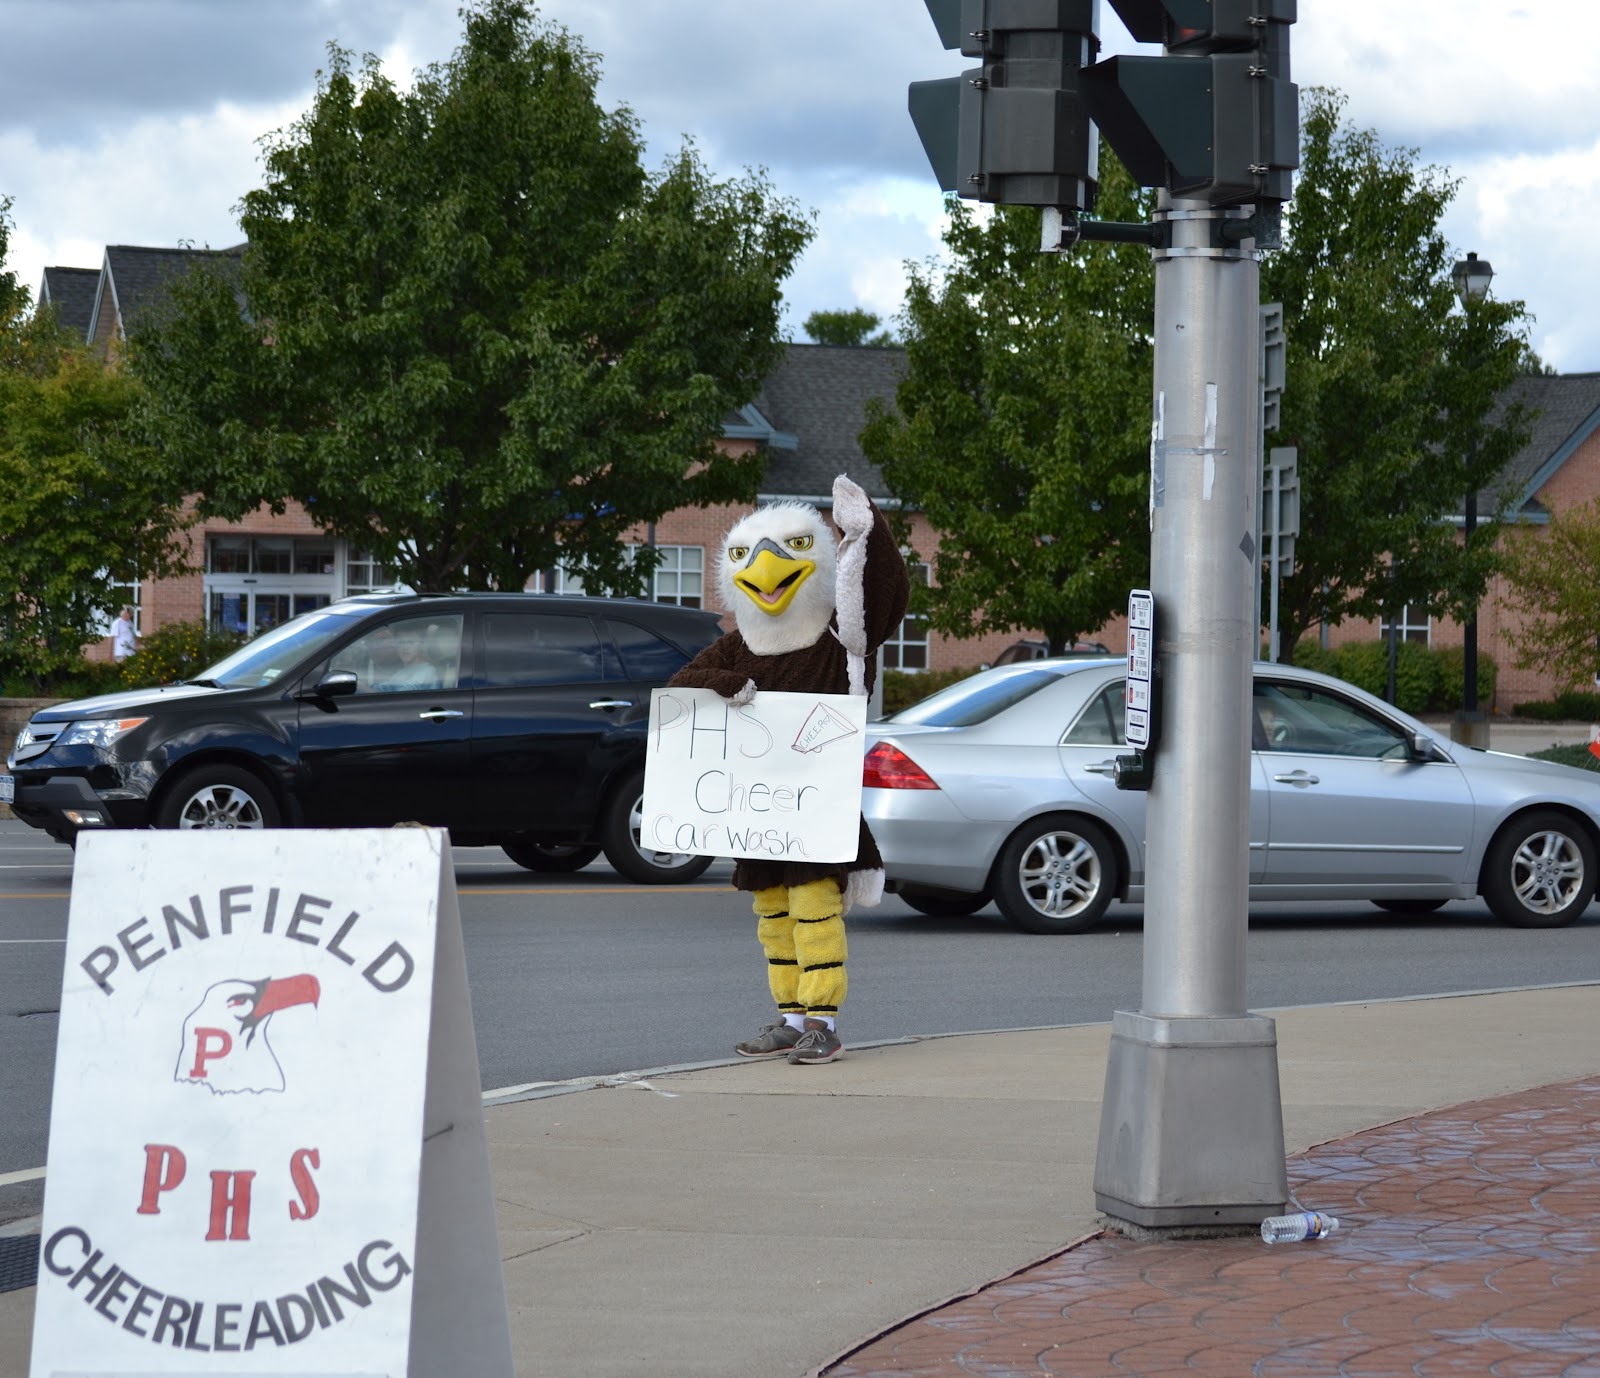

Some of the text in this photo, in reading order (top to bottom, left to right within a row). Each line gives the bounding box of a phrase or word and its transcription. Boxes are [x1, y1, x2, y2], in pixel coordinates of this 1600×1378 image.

[656, 694, 774, 760] PHS
[695, 769, 818, 814] Cheer
[652, 813, 719, 850] Car
[80, 885, 415, 997] PENFIELD
[189, 1026, 232, 1078] P
[43, 1226, 412, 1352] CHEERLEADING
